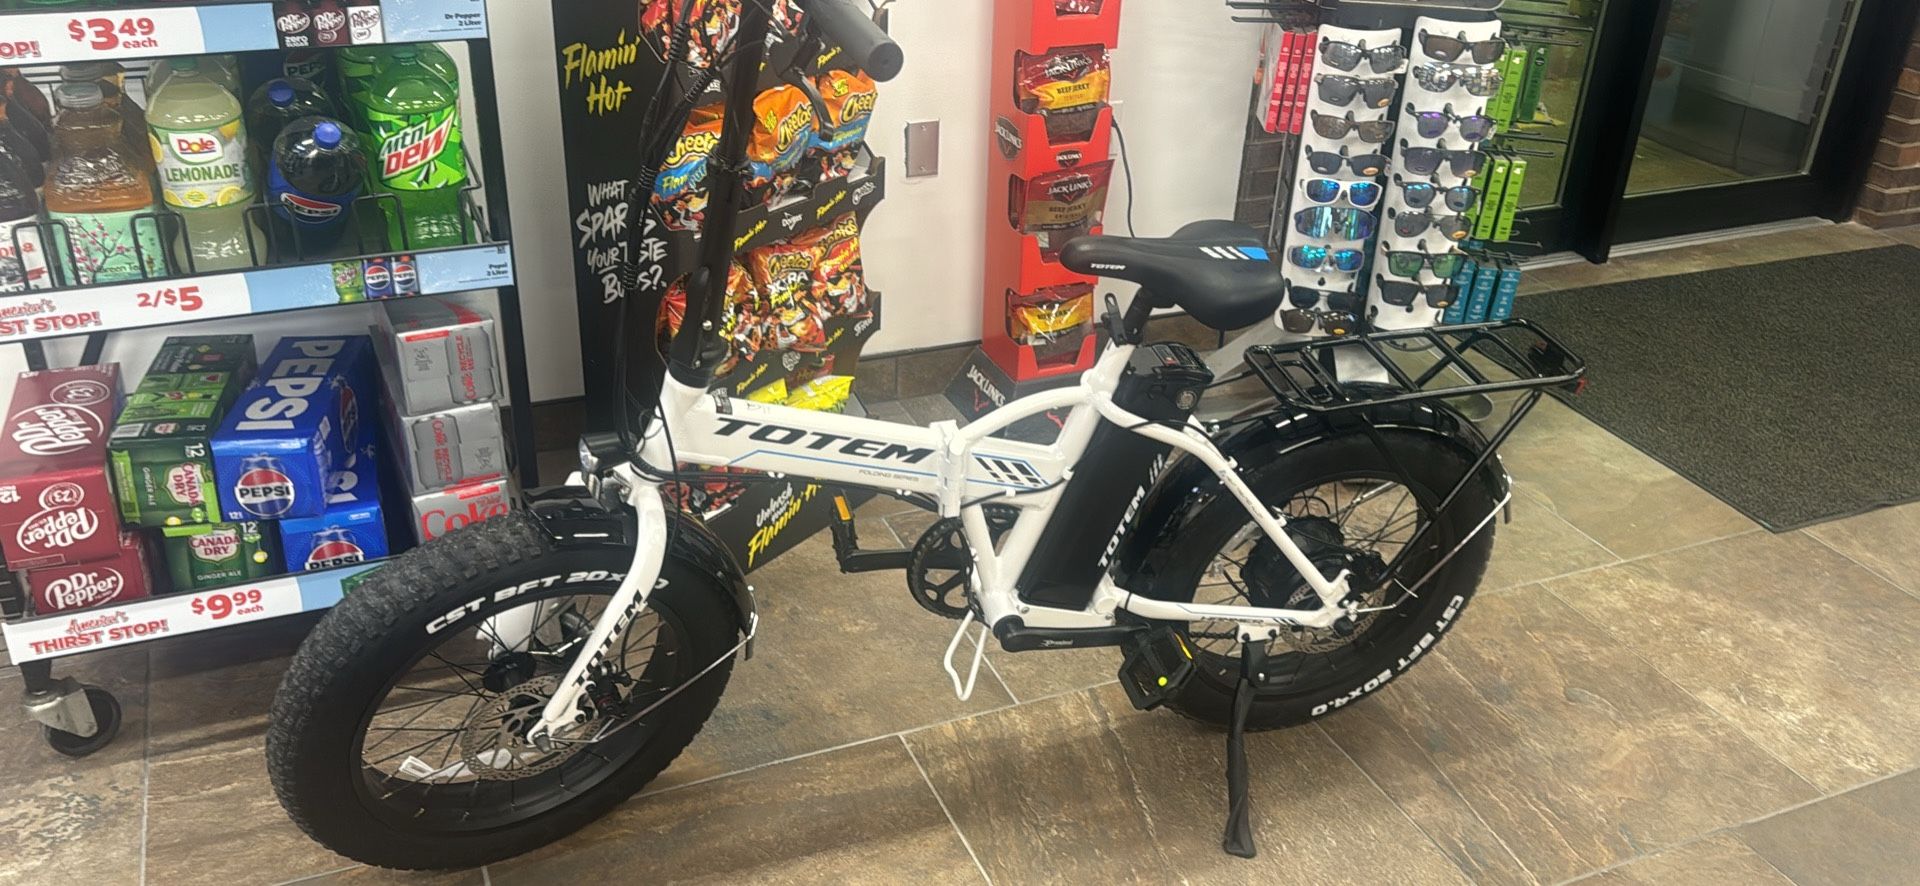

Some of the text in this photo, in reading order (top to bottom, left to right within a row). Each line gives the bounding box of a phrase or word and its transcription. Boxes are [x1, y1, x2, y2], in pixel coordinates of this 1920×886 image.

[122, 37, 158, 49] each
[562, 28, 641, 90] Flamin'
[587, 74, 632, 117] Hot
[177, 137, 217, 153] Dole
[164, 163, 241, 183] LEMONADE
[587, 179, 629, 208] WHAT
[1046, 184, 1069, 195] JACK
[488, 262, 508, 271] Pepsi
[587, 246, 621, 274] YOUR
[1090, 262, 1127, 271] TOTEM
[137, 286, 203, 312] 2/$5
[34, 311, 102, 334] STOP!
[235, 339, 346, 431] PEPSI
[966, 364, 987, 392] JACK
[20, 407, 94, 456] Pepper
[714, 417, 937, 465] TOTEM
[173, 474, 187, 497] DRY
[182, 461, 200, 506] CANADA
[859, 469, 920, 483] FOLDING SERIES
[238, 482, 292, 500] PEPSI
[23, 507, 93, 547] Pepper
[240, 521, 258, 534] 12
[1097, 485, 1146, 568] TOTEM
[190, 534, 241, 550] CANADA
[203, 545, 231, 556] DRY
[309, 554, 363, 570] PEPSI
[72, 572, 98, 588] Dr
[197, 569, 243, 582] GINGER ALE
[46, 575, 118, 611] Pepper
[426, 596, 487, 635] CST
[494, 574, 562, 603] BFT
[237, 605, 265, 616] each
[29, 619, 170, 655] THIRST STOP!
[573, 589, 649, 688] TOTEM
[1311, 594, 1465, 717] CST BFT 20x4.0
